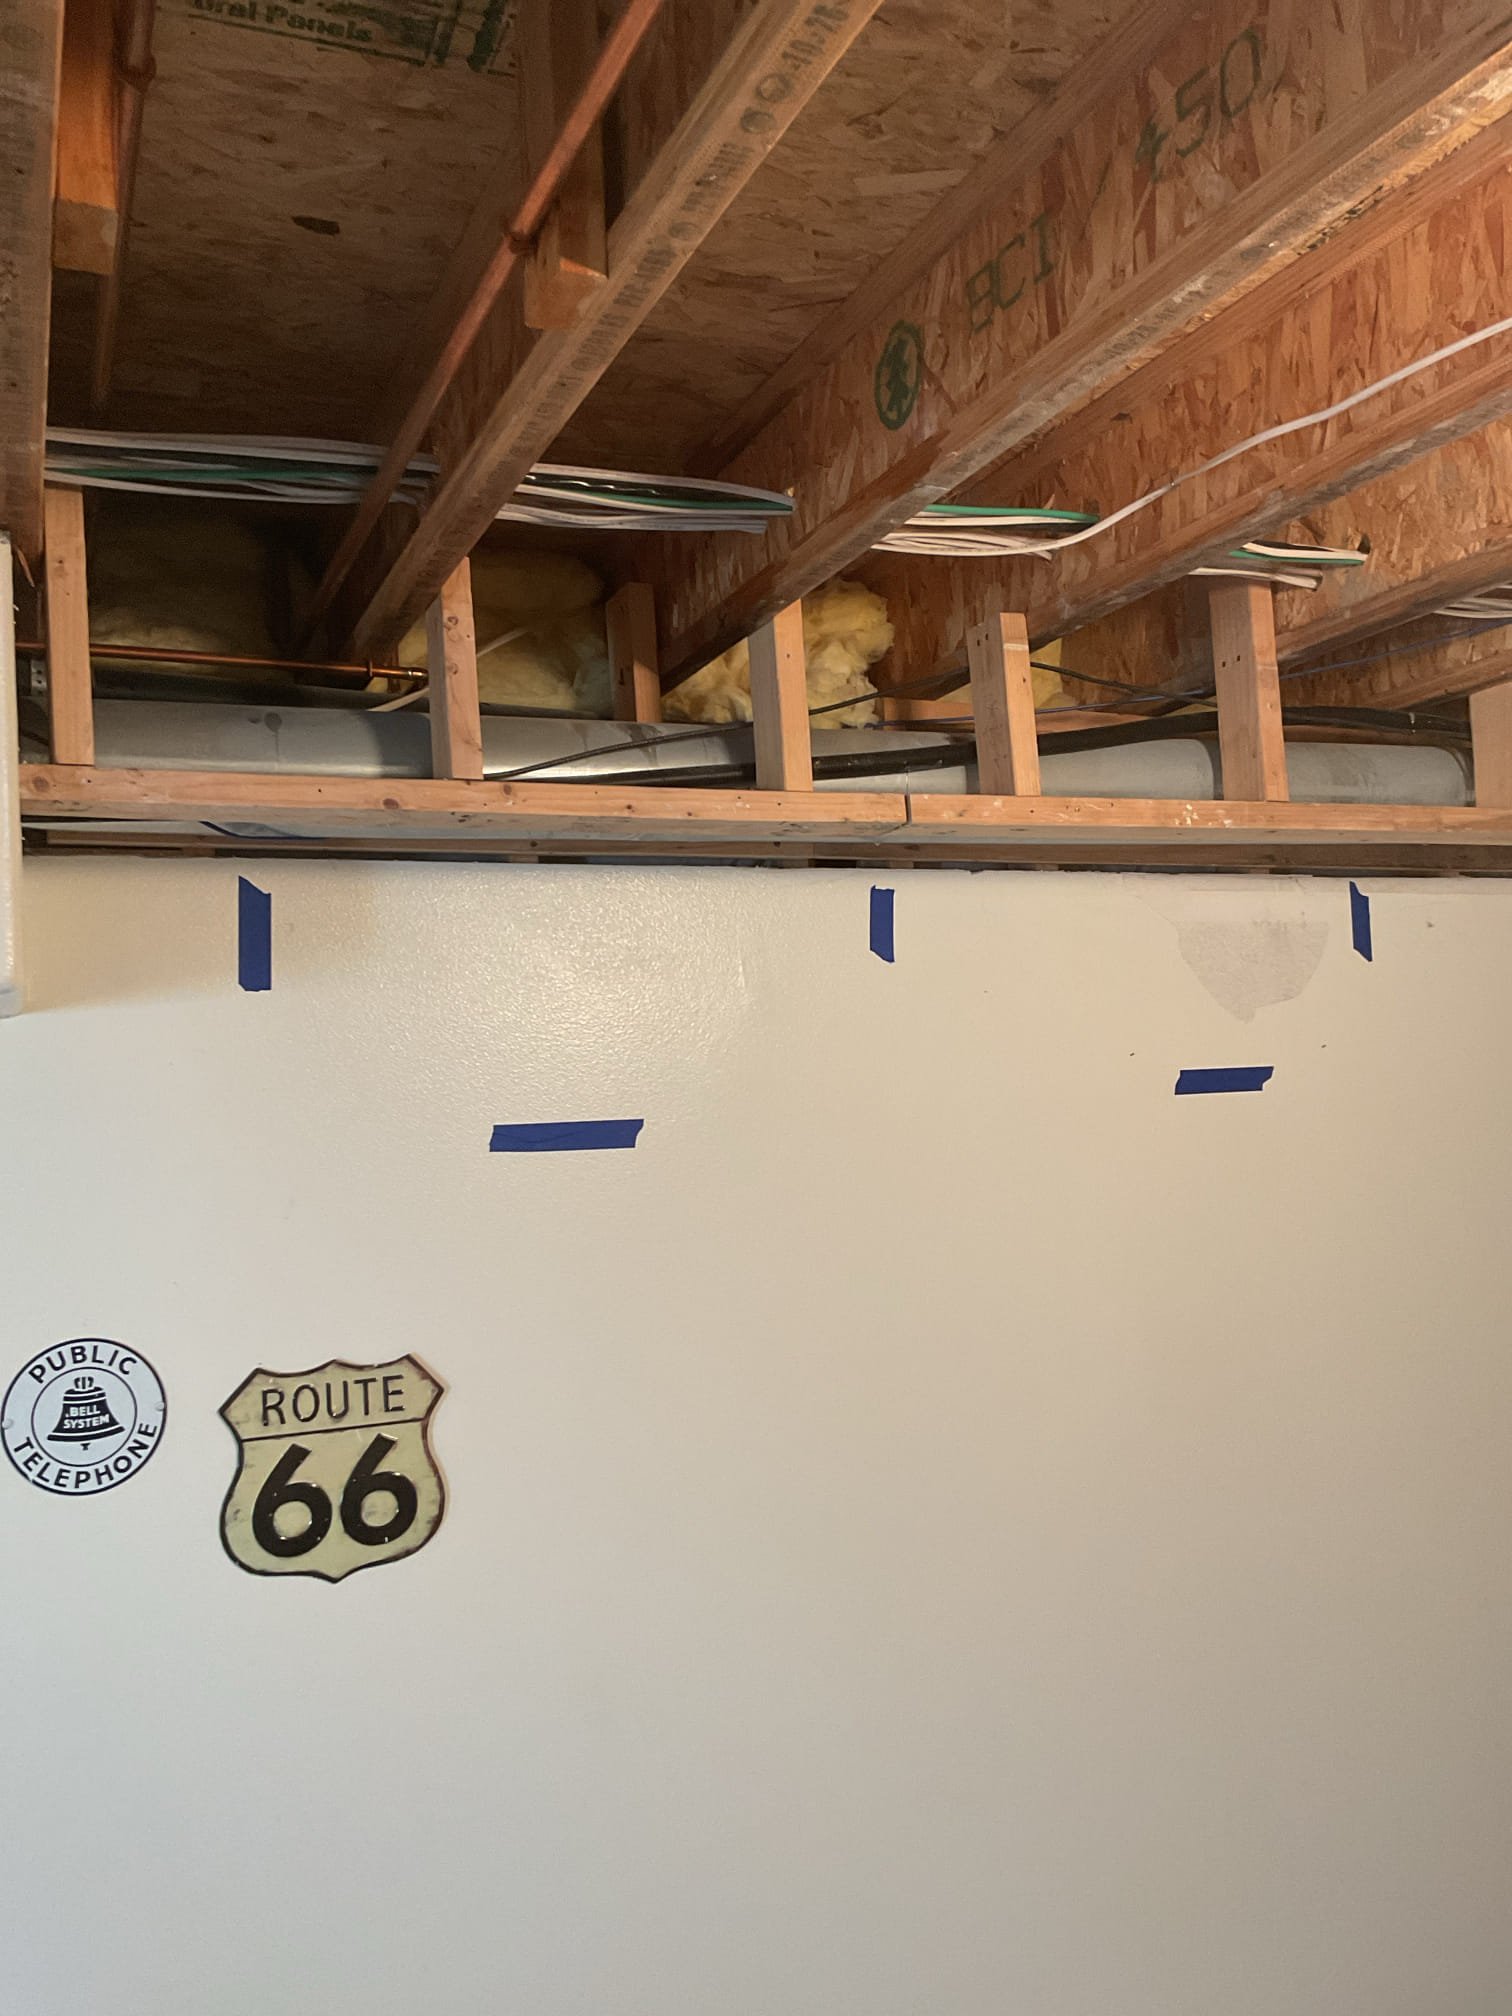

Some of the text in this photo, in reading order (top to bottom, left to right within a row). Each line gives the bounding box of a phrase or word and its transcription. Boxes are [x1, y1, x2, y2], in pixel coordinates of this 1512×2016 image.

[265, 5, 373, 41] Panels
[965, 212, 1057, 335] BCI
[1134, 27, 1263, 182] 450
[28, 1345, 137, 1384] PUBLIC
[63, 1413, 110, 1429] SYSTEM
[69, 1404, 101, 1417] BELL
[261, 1374, 406, 1426] ROUTE
[13, 1422, 158, 1489] TELEPHONE
[252, 1432, 418, 1558] 66
